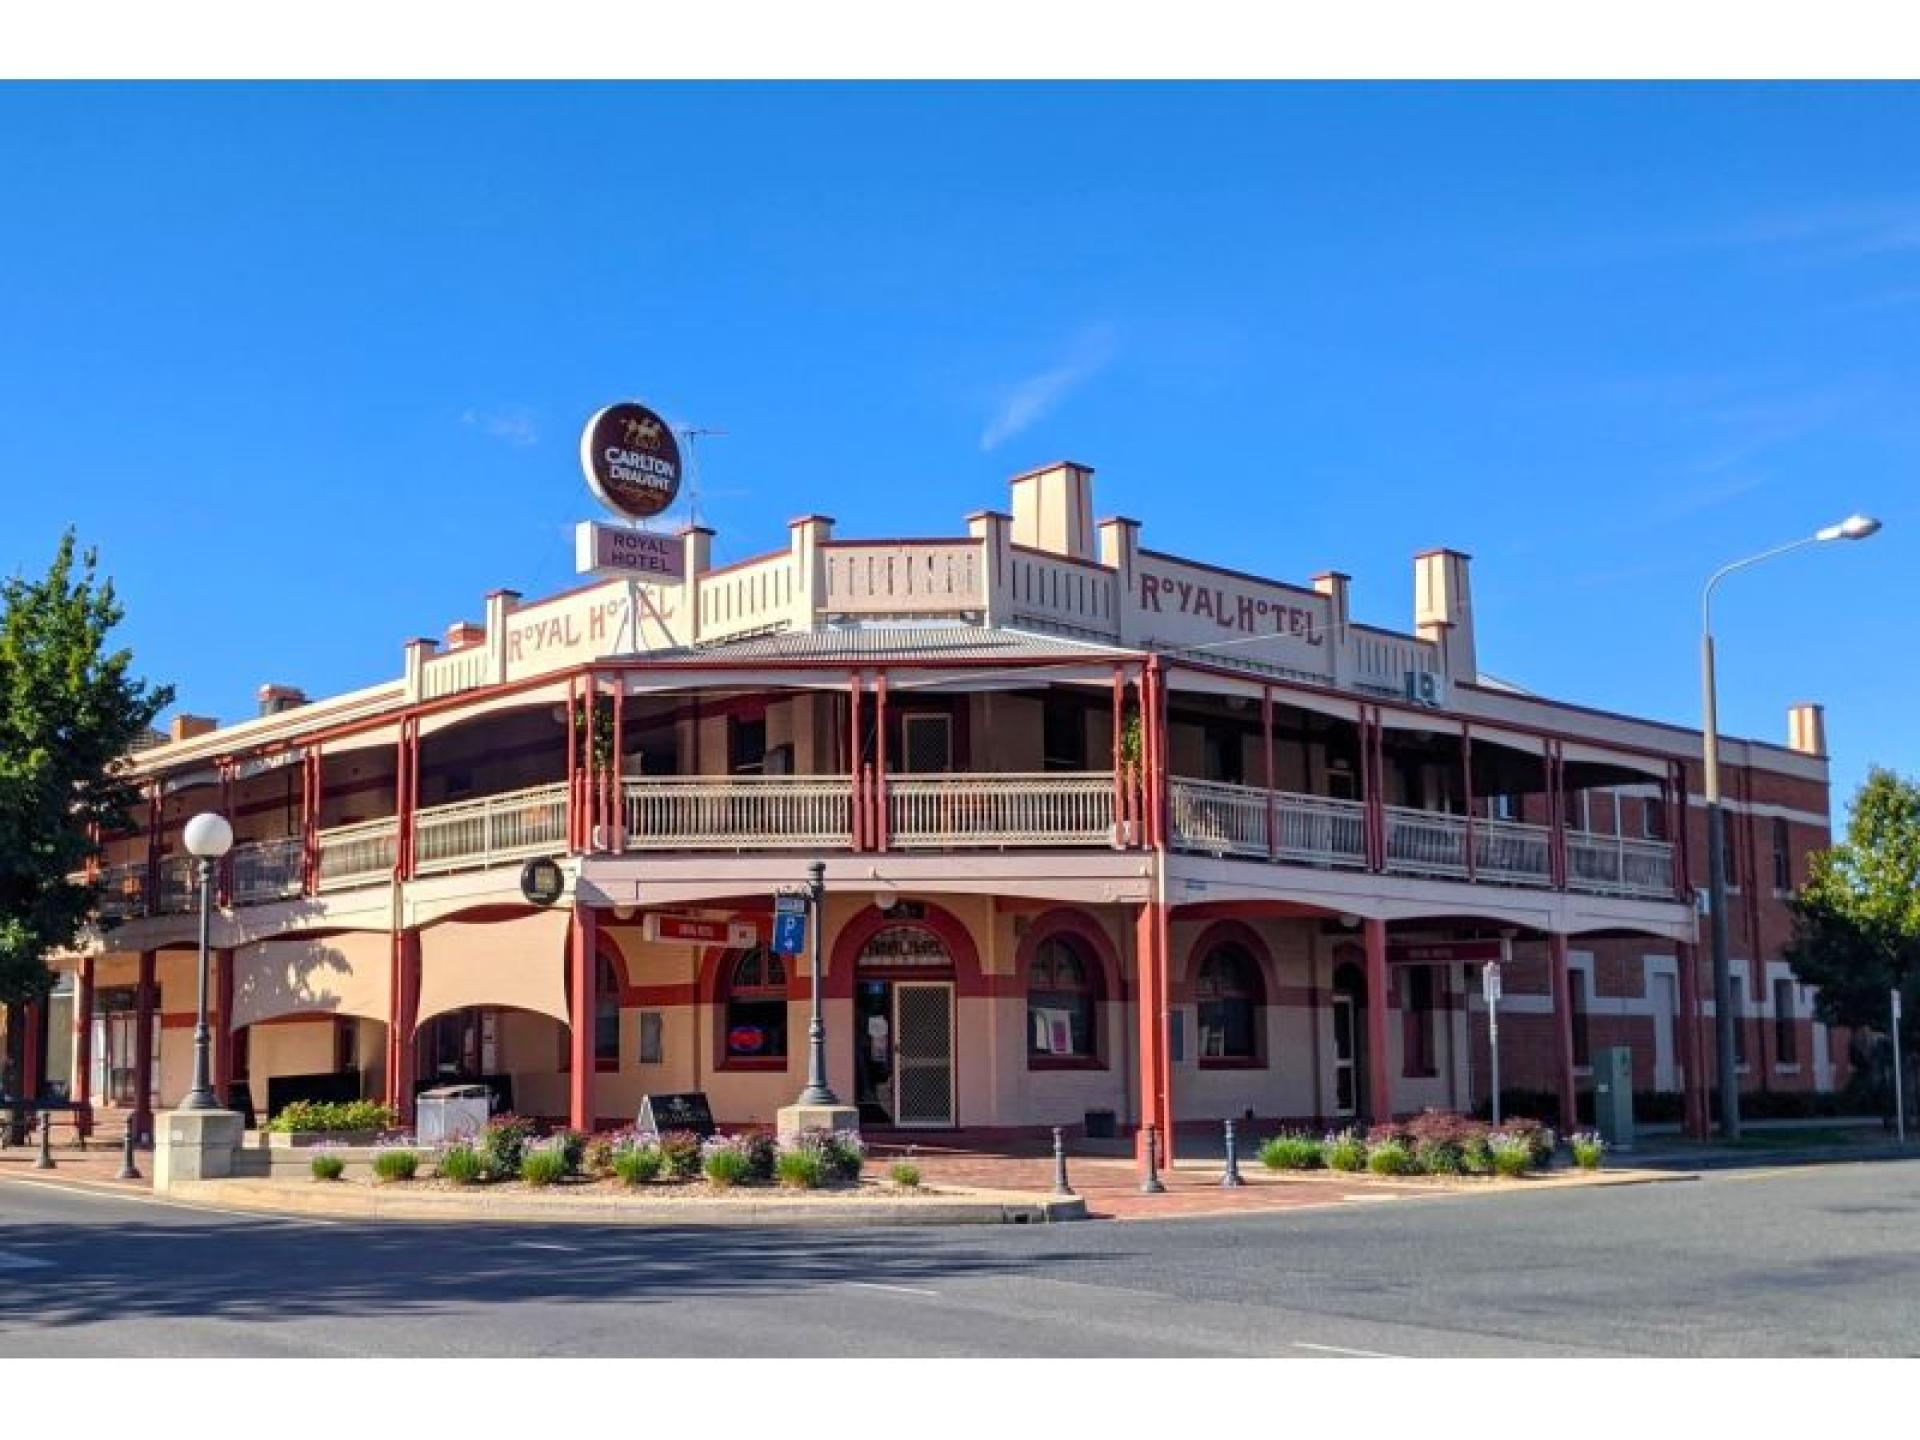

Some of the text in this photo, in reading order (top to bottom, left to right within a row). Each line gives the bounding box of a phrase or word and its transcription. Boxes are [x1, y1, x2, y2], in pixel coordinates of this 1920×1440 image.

[604, 447, 675, 478] CARLTON
[609, 464, 671, 491] DRAUGHT
[614, 533, 670, 555] ROYAL
[611, 551, 673, 572] HOTEL
[1140, 573, 1324, 647] ROYAL HOTEL
[508, 614, 581, 662] ROYAL
